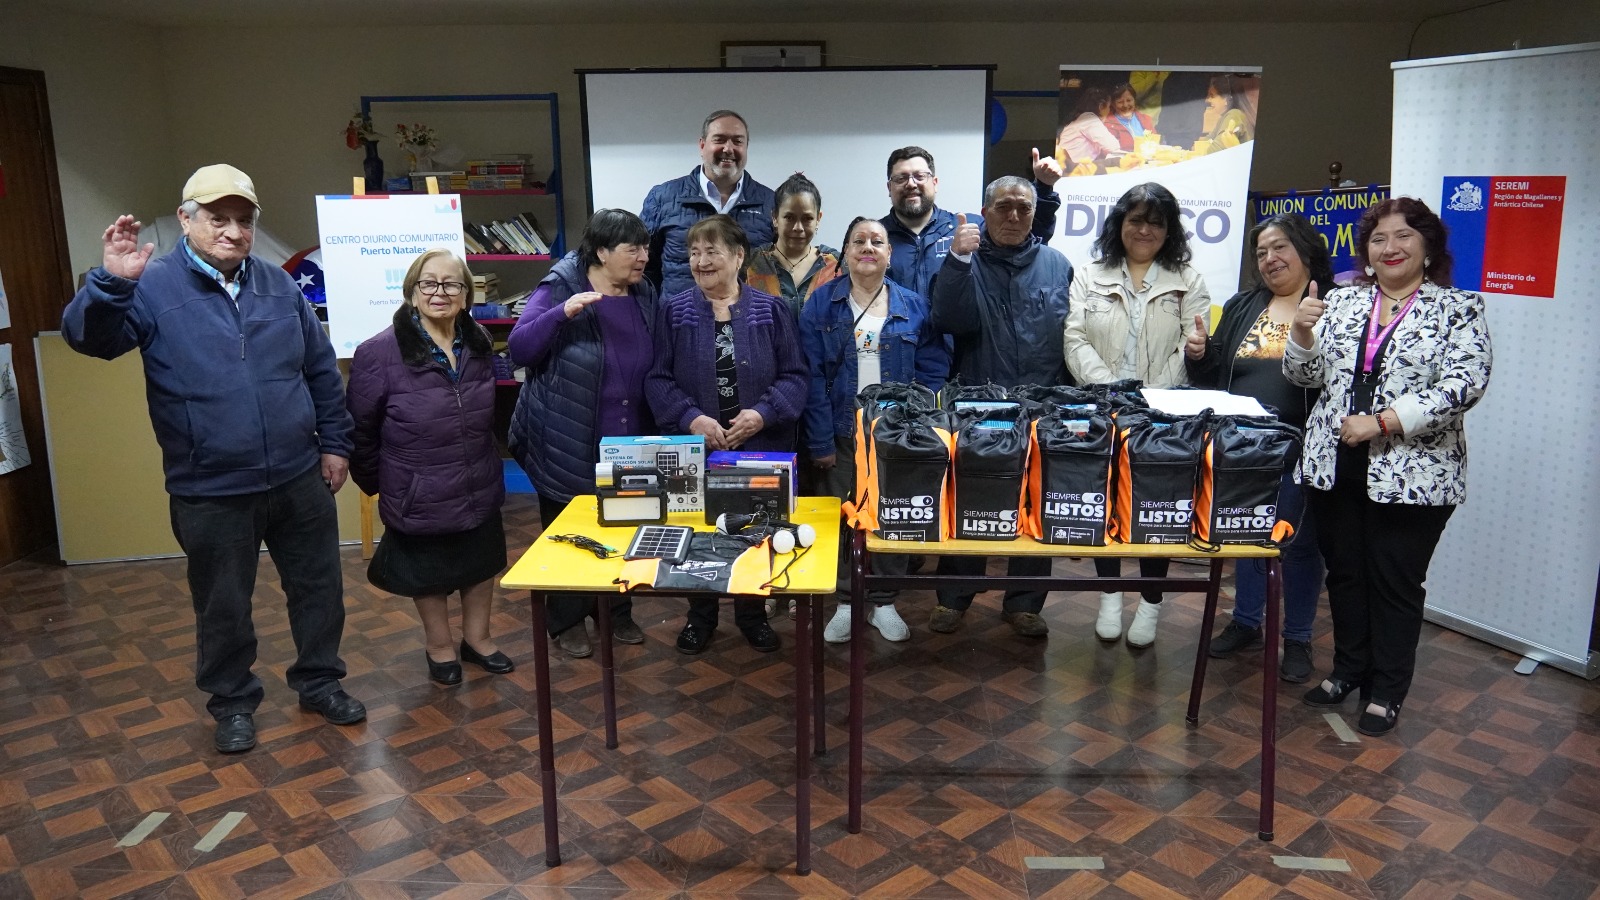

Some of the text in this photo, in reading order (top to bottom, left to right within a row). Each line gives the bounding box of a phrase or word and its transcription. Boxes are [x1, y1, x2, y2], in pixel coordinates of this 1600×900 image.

[1495, 181, 1530, 190] SEREMI
[1067, 193, 1109, 203] DIRECCIÓN
[1494, 193, 1514, 201] Región
[1523, 193, 1558, 202] Magallanes
[1260, 197, 1305, 216] UNION
[1309, 214, 1331, 226] DEL
[325, 232, 459, 245] CENTRO DIURNO COMUNITARIO
[360, 245, 427, 256] Puerto Natales
[1486, 271, 1536, 282] Ministerio de
[1485, 280, 1514, 290] Energía
[1045, 491, 1081, 501] SIEMPRE
[1044, 501, 1105, 518] LISTOS
[1140, 500, 1175, 509] SIEMPRE
[963, 509, 999, 519] SIEMPRE
[1217, 507, 1254, 515] SIEMPRE
[962, 518, 1017, 533] LISTOS
[1215, 516, 1275, 529] LISTOS
